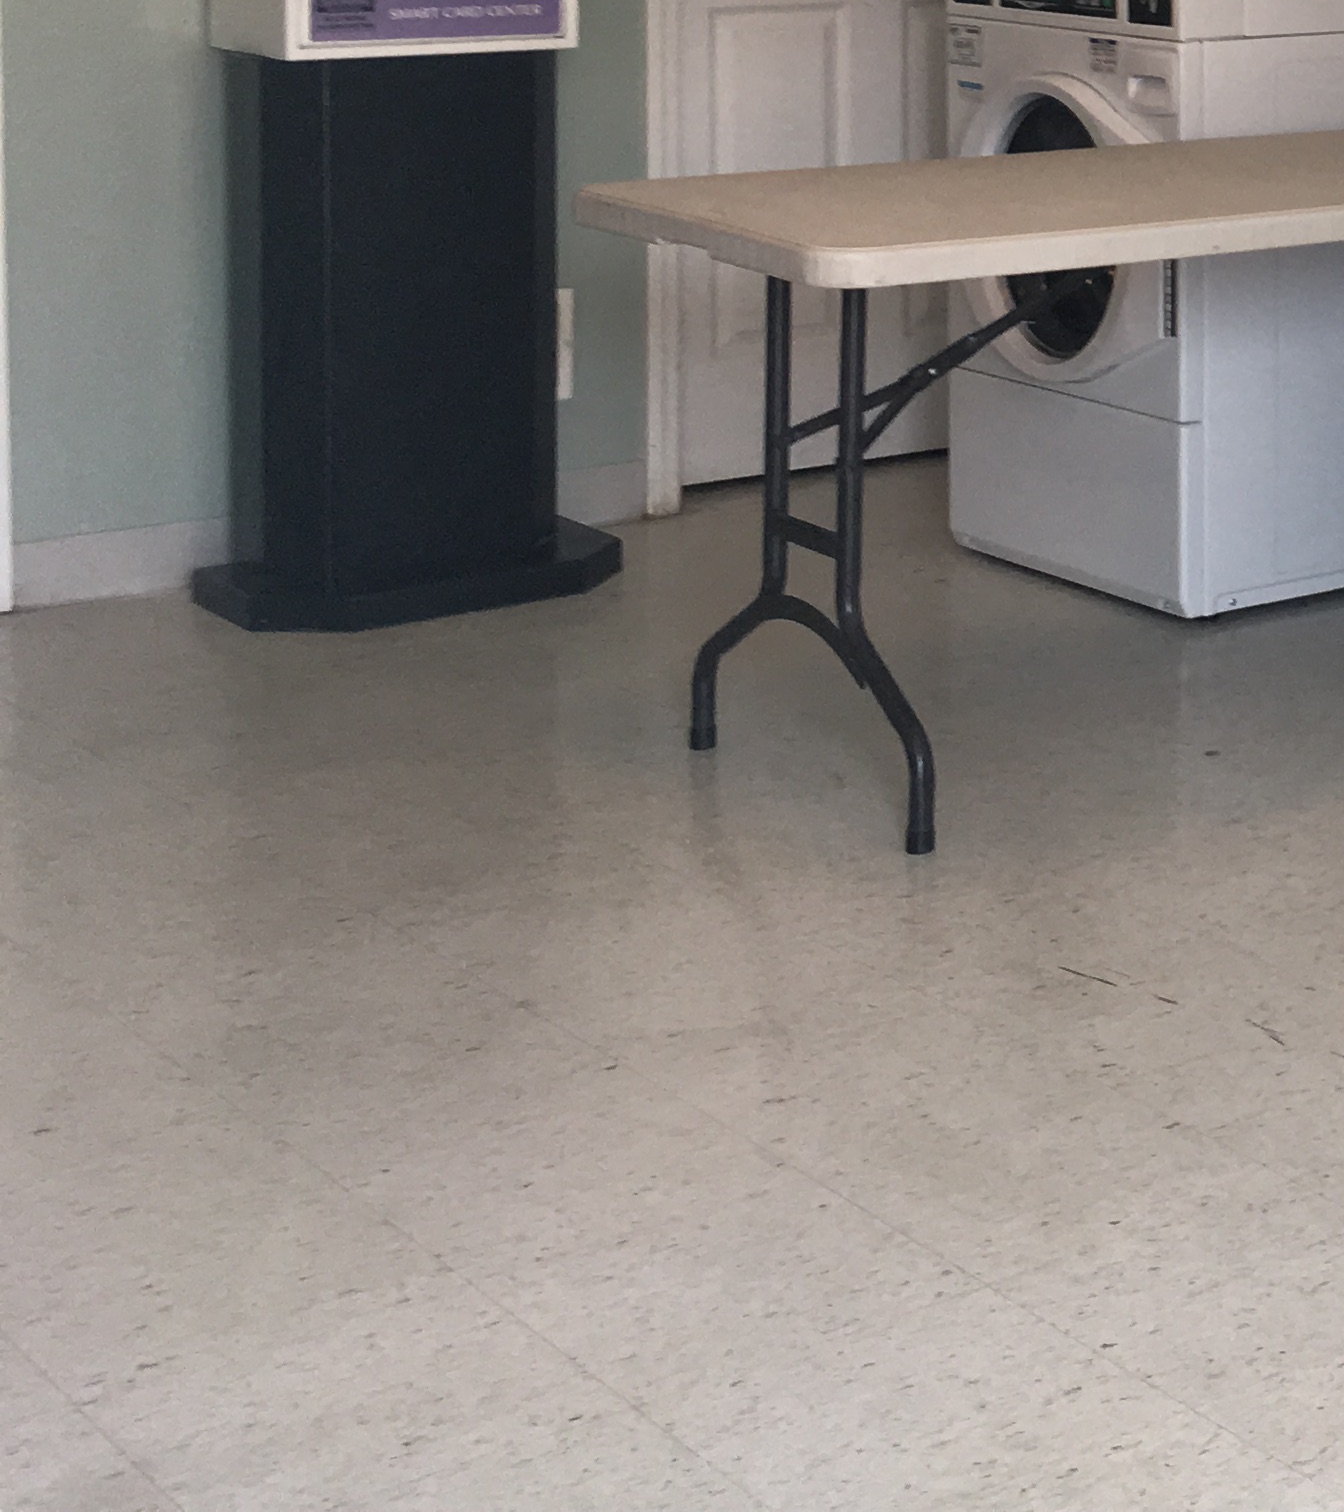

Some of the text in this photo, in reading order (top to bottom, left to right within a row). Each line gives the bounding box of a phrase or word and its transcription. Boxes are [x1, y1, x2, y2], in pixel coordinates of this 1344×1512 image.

[389, 3, 543, 20] SMART CARD CENTER
